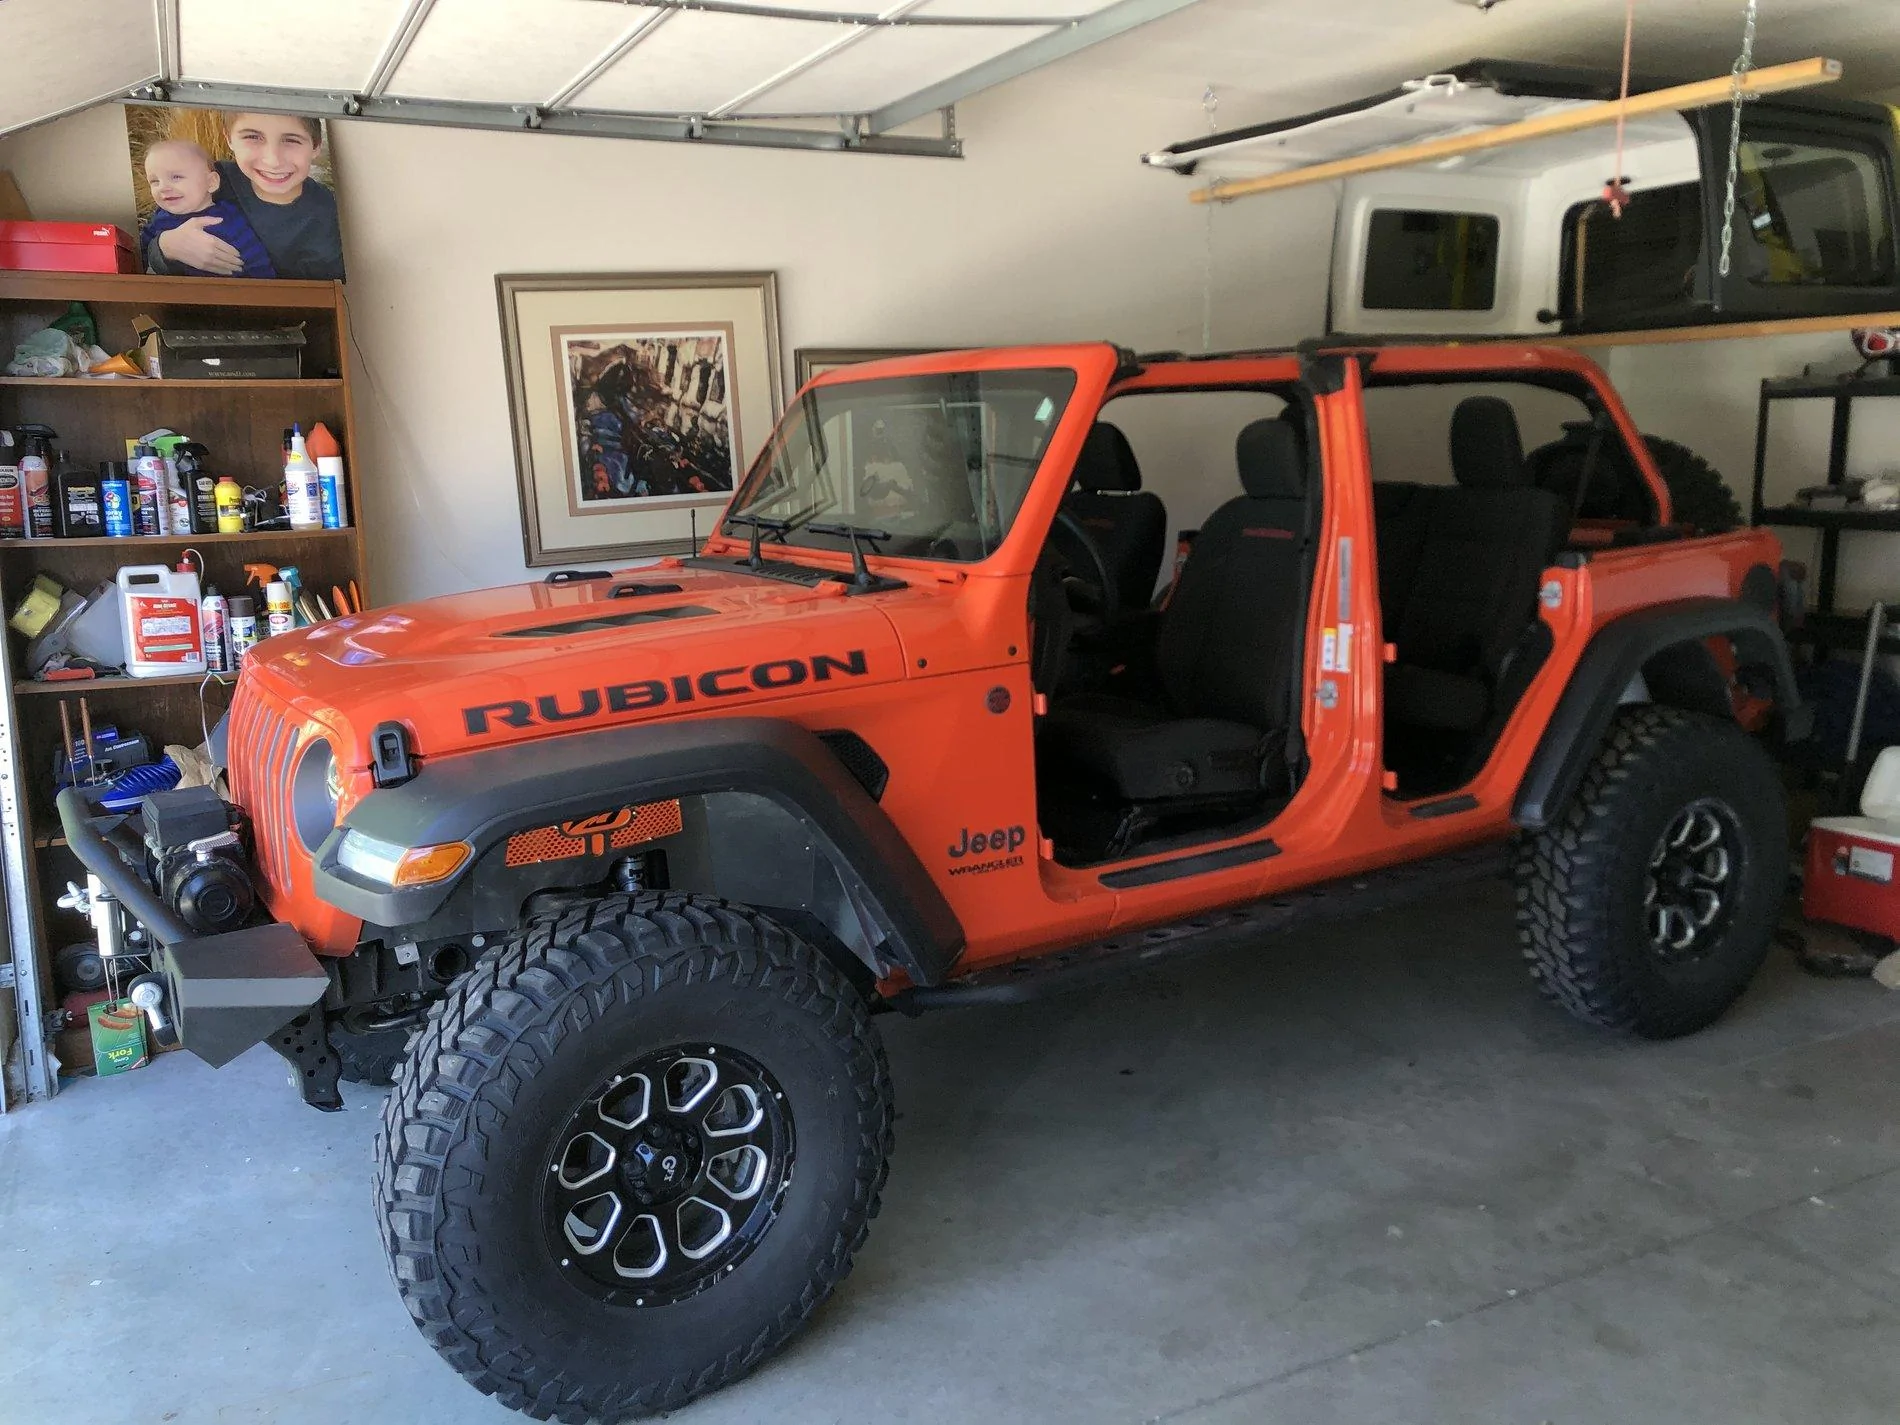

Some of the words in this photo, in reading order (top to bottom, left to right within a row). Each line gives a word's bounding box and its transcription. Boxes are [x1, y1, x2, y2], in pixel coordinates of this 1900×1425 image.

[461, 648, 869, 737] RUBICON
[948, 825, 1025, 858] Jeep
[107, 1047, 133, 1060] Fork
